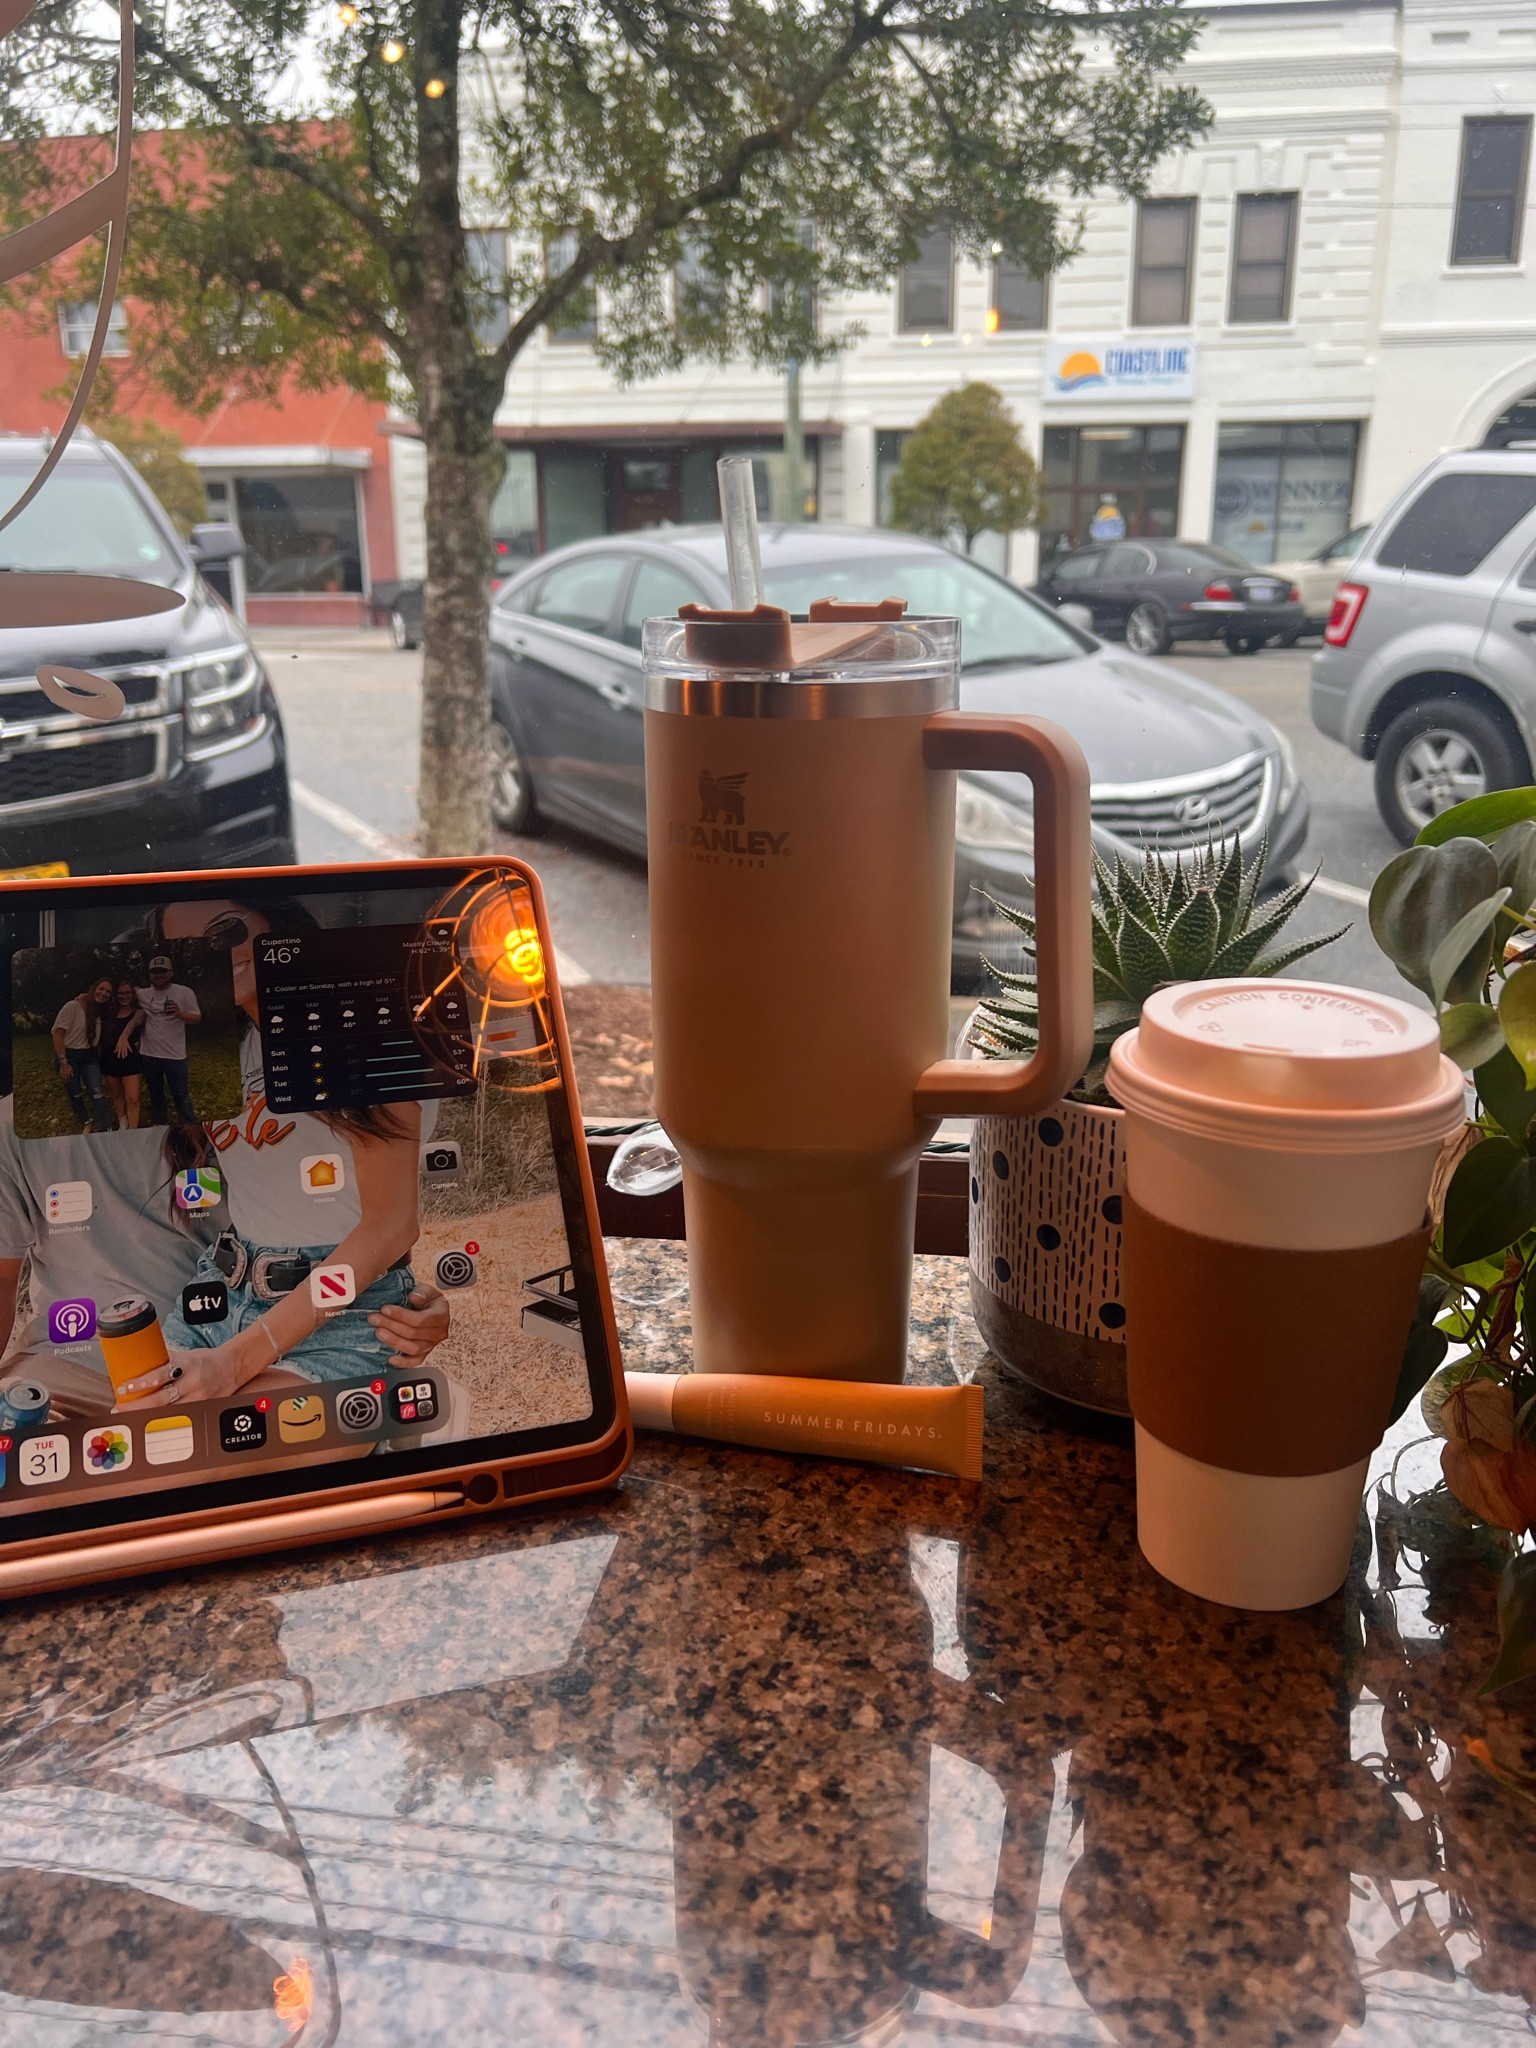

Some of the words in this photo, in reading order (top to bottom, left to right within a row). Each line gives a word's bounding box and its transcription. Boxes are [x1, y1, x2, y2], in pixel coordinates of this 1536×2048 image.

[681, 852, 719, 865] SINCE
[261, 937, 301, 946] Cupertino
[426, 939, 450, 947] Cloudy
[263, 947, 300, 964] 46°
[274, 984, 297, 993] Cooler
[1197, 992, 1266, 1012] CAUTION
[1278, 992, 1370, 1016] CONTENTS
[1366, 1017, 1395, 1035] HOT
[274, 1095, 292, 1103] Wed
[431, 1181, 459, 1190] Camera
[189, 1210, 210, 1219] Maps
[48, 1224, 91, 1235] Reminders
[469, 1244, 476, 1252] 3
[202, 1295, 222, 1310] tv
[325, 1309, 346, 1318] News
[54, 1343, 92, 1355] Podcasts
[375, 1382, 382, 1392] 3
[259, 1399, 267, 1409] 4
[763, 1411, 844, 1431] SUMMER
[225, 1432, 262, 1444] CREATOR
[34, 1440, 55, 1451] TUE
[30, 1451, 58, 1477] 31
